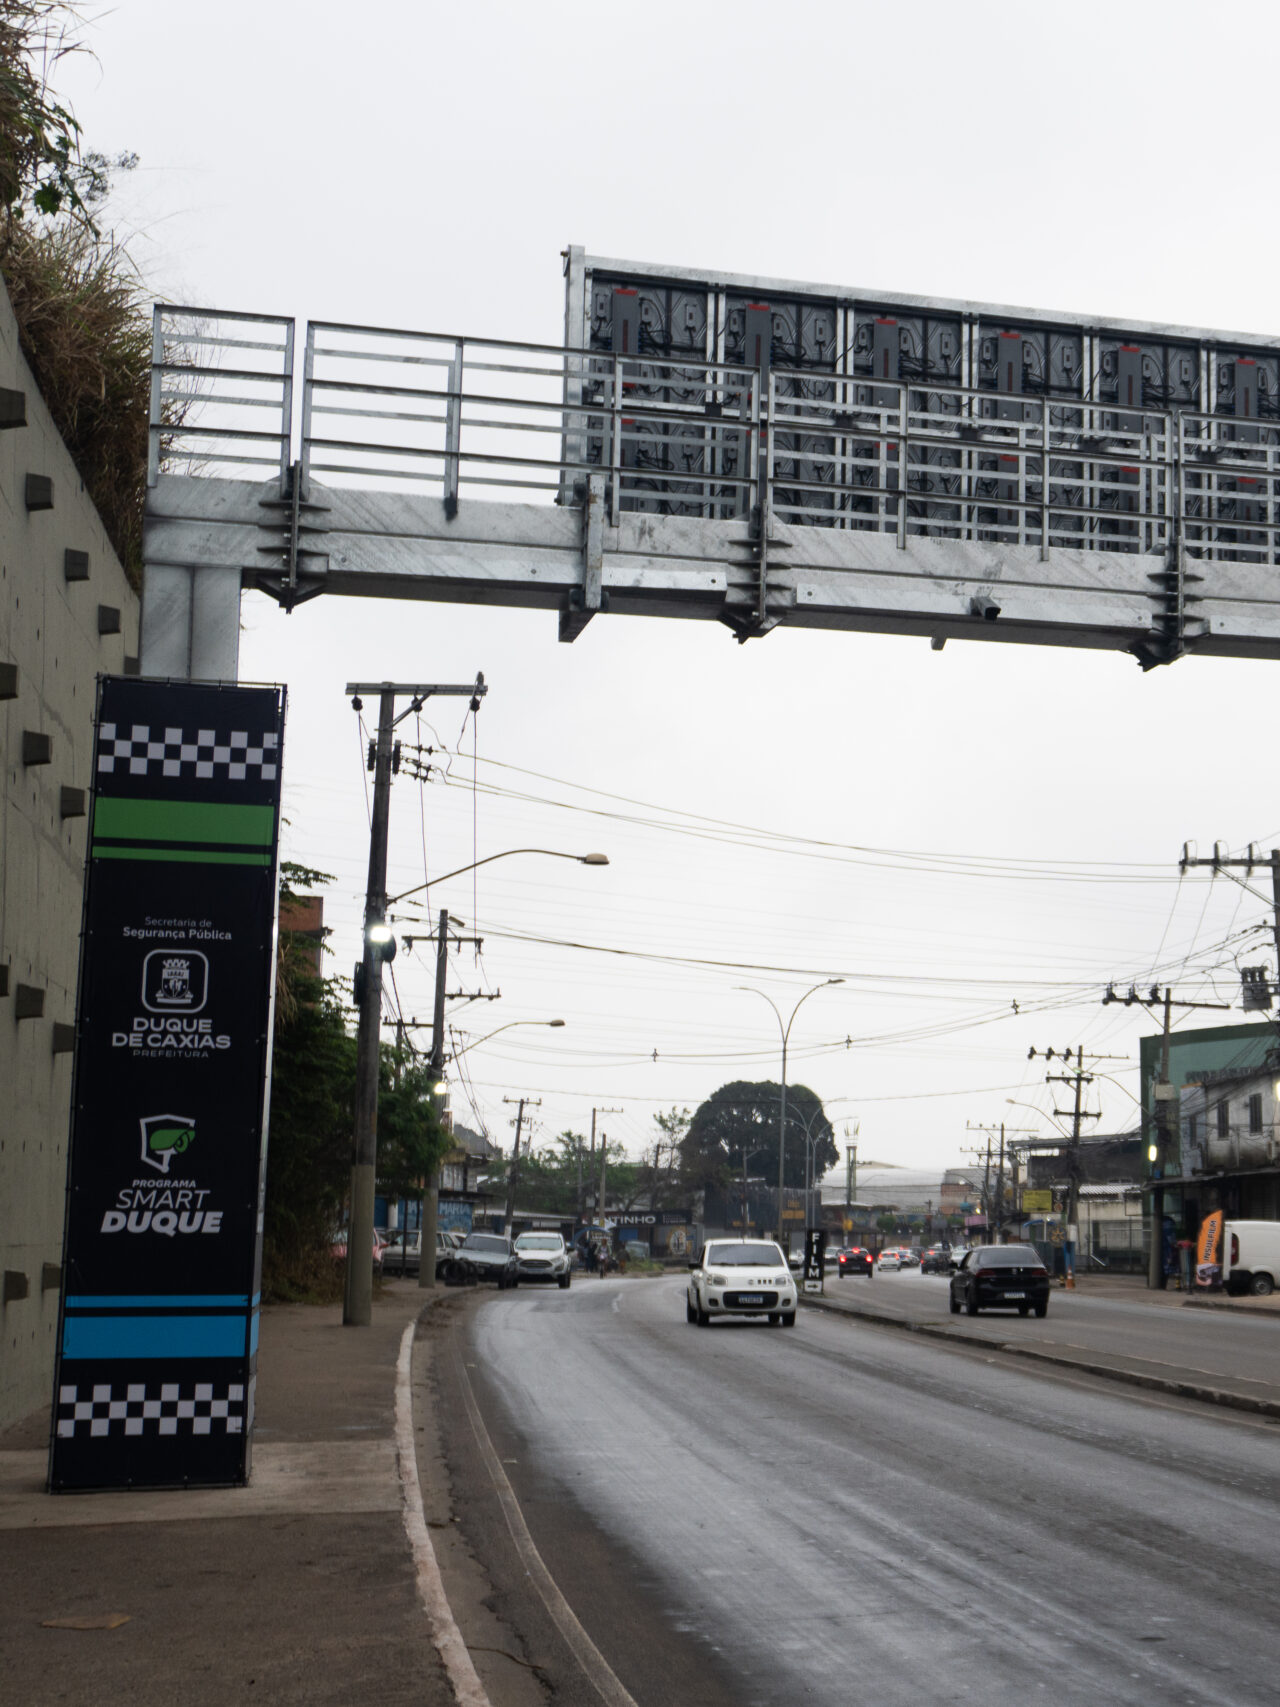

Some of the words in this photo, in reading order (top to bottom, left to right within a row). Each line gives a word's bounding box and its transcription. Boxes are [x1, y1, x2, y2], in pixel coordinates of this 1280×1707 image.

[145, 916, 197, 927] Secretaria
[199, 919, 212, 928] de
[123, 926, 186, 940] Segurança
[188, 929, 232, 940] Pública
[133, 1017, 213, 1033] DUQUE
[112, 1032, 144, 1047] DE
[146, 1033, 231, 1049] CAXIAS
[133, 1049, 209, 1058] PREFEITURA
[132, 1180, 197, 1188] PROGRAMA
[115, 1189, 211, 1209] SMART
[100, 1210, 224, 1237] DUQUE
[808, 1232, 820, 1278] FILM
